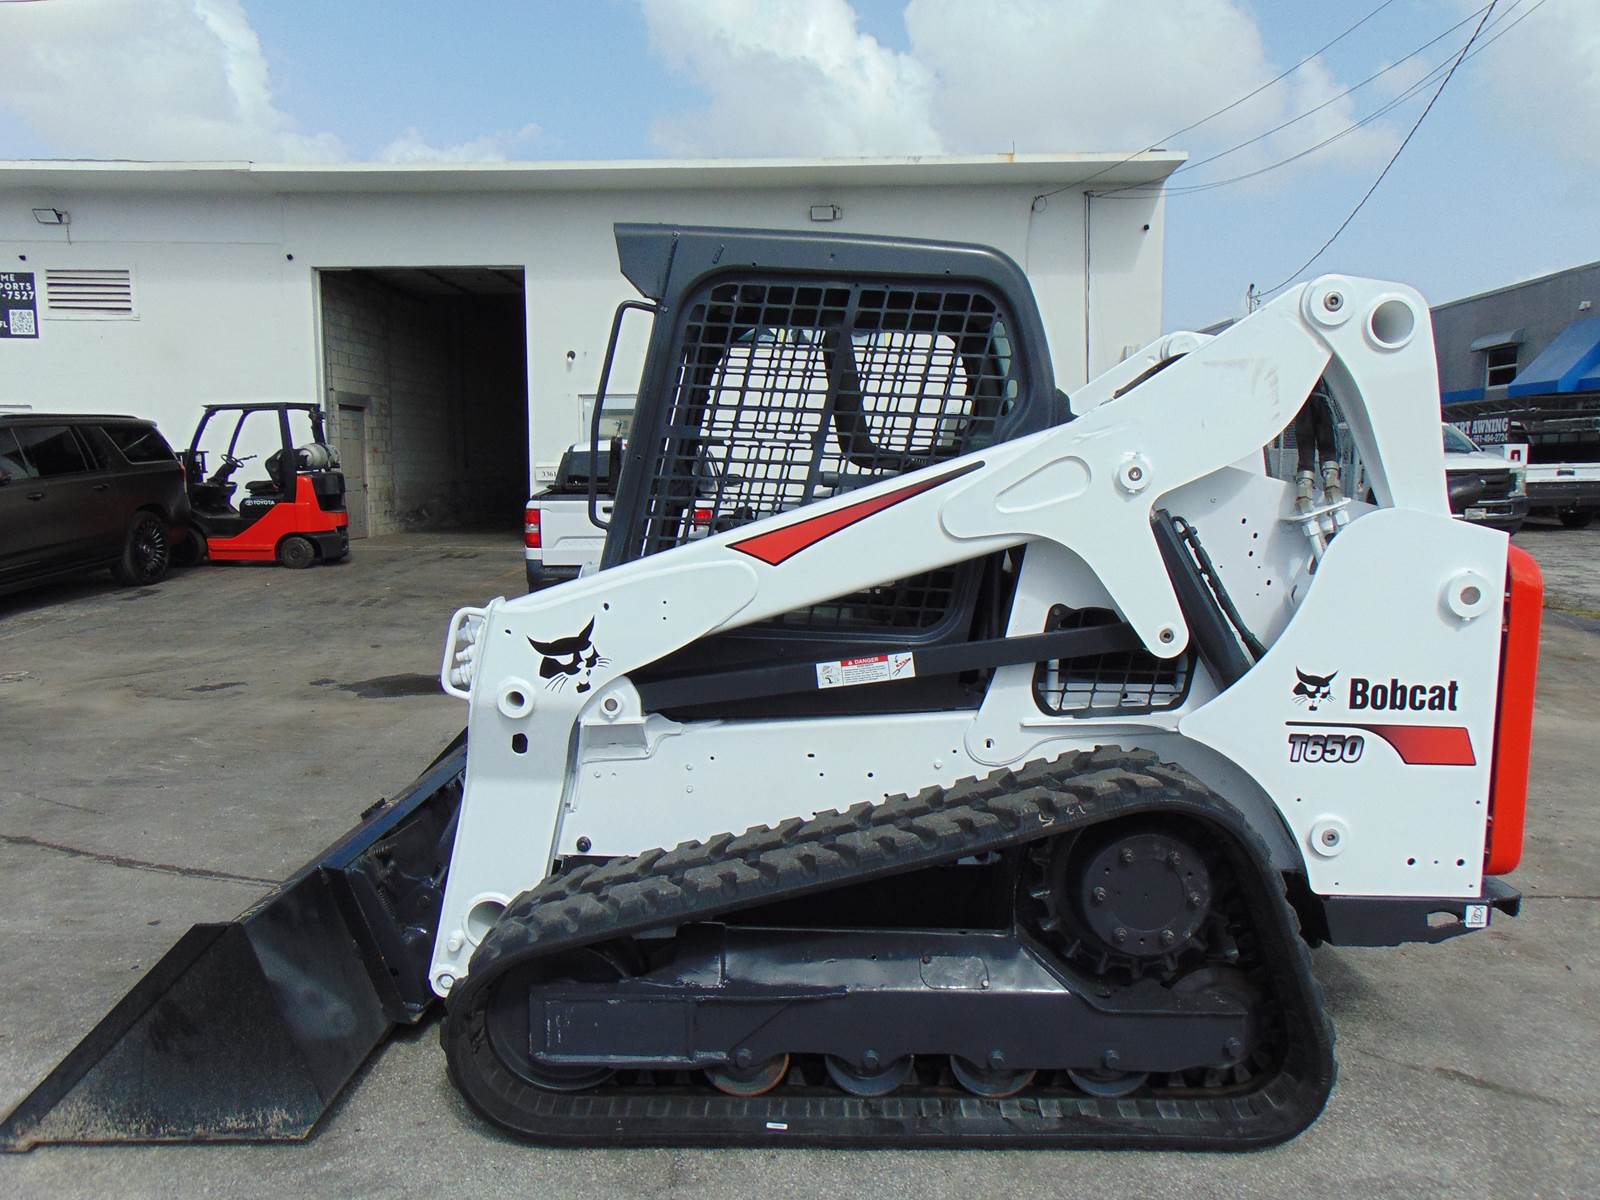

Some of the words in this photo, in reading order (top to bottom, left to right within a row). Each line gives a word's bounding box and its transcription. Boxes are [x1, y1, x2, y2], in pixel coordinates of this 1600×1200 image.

[1472, 417, 1509, 434] AWNING
[1349, 678, 1458, 711] Bobcat
[1289, 733, 1364, 763] T650
